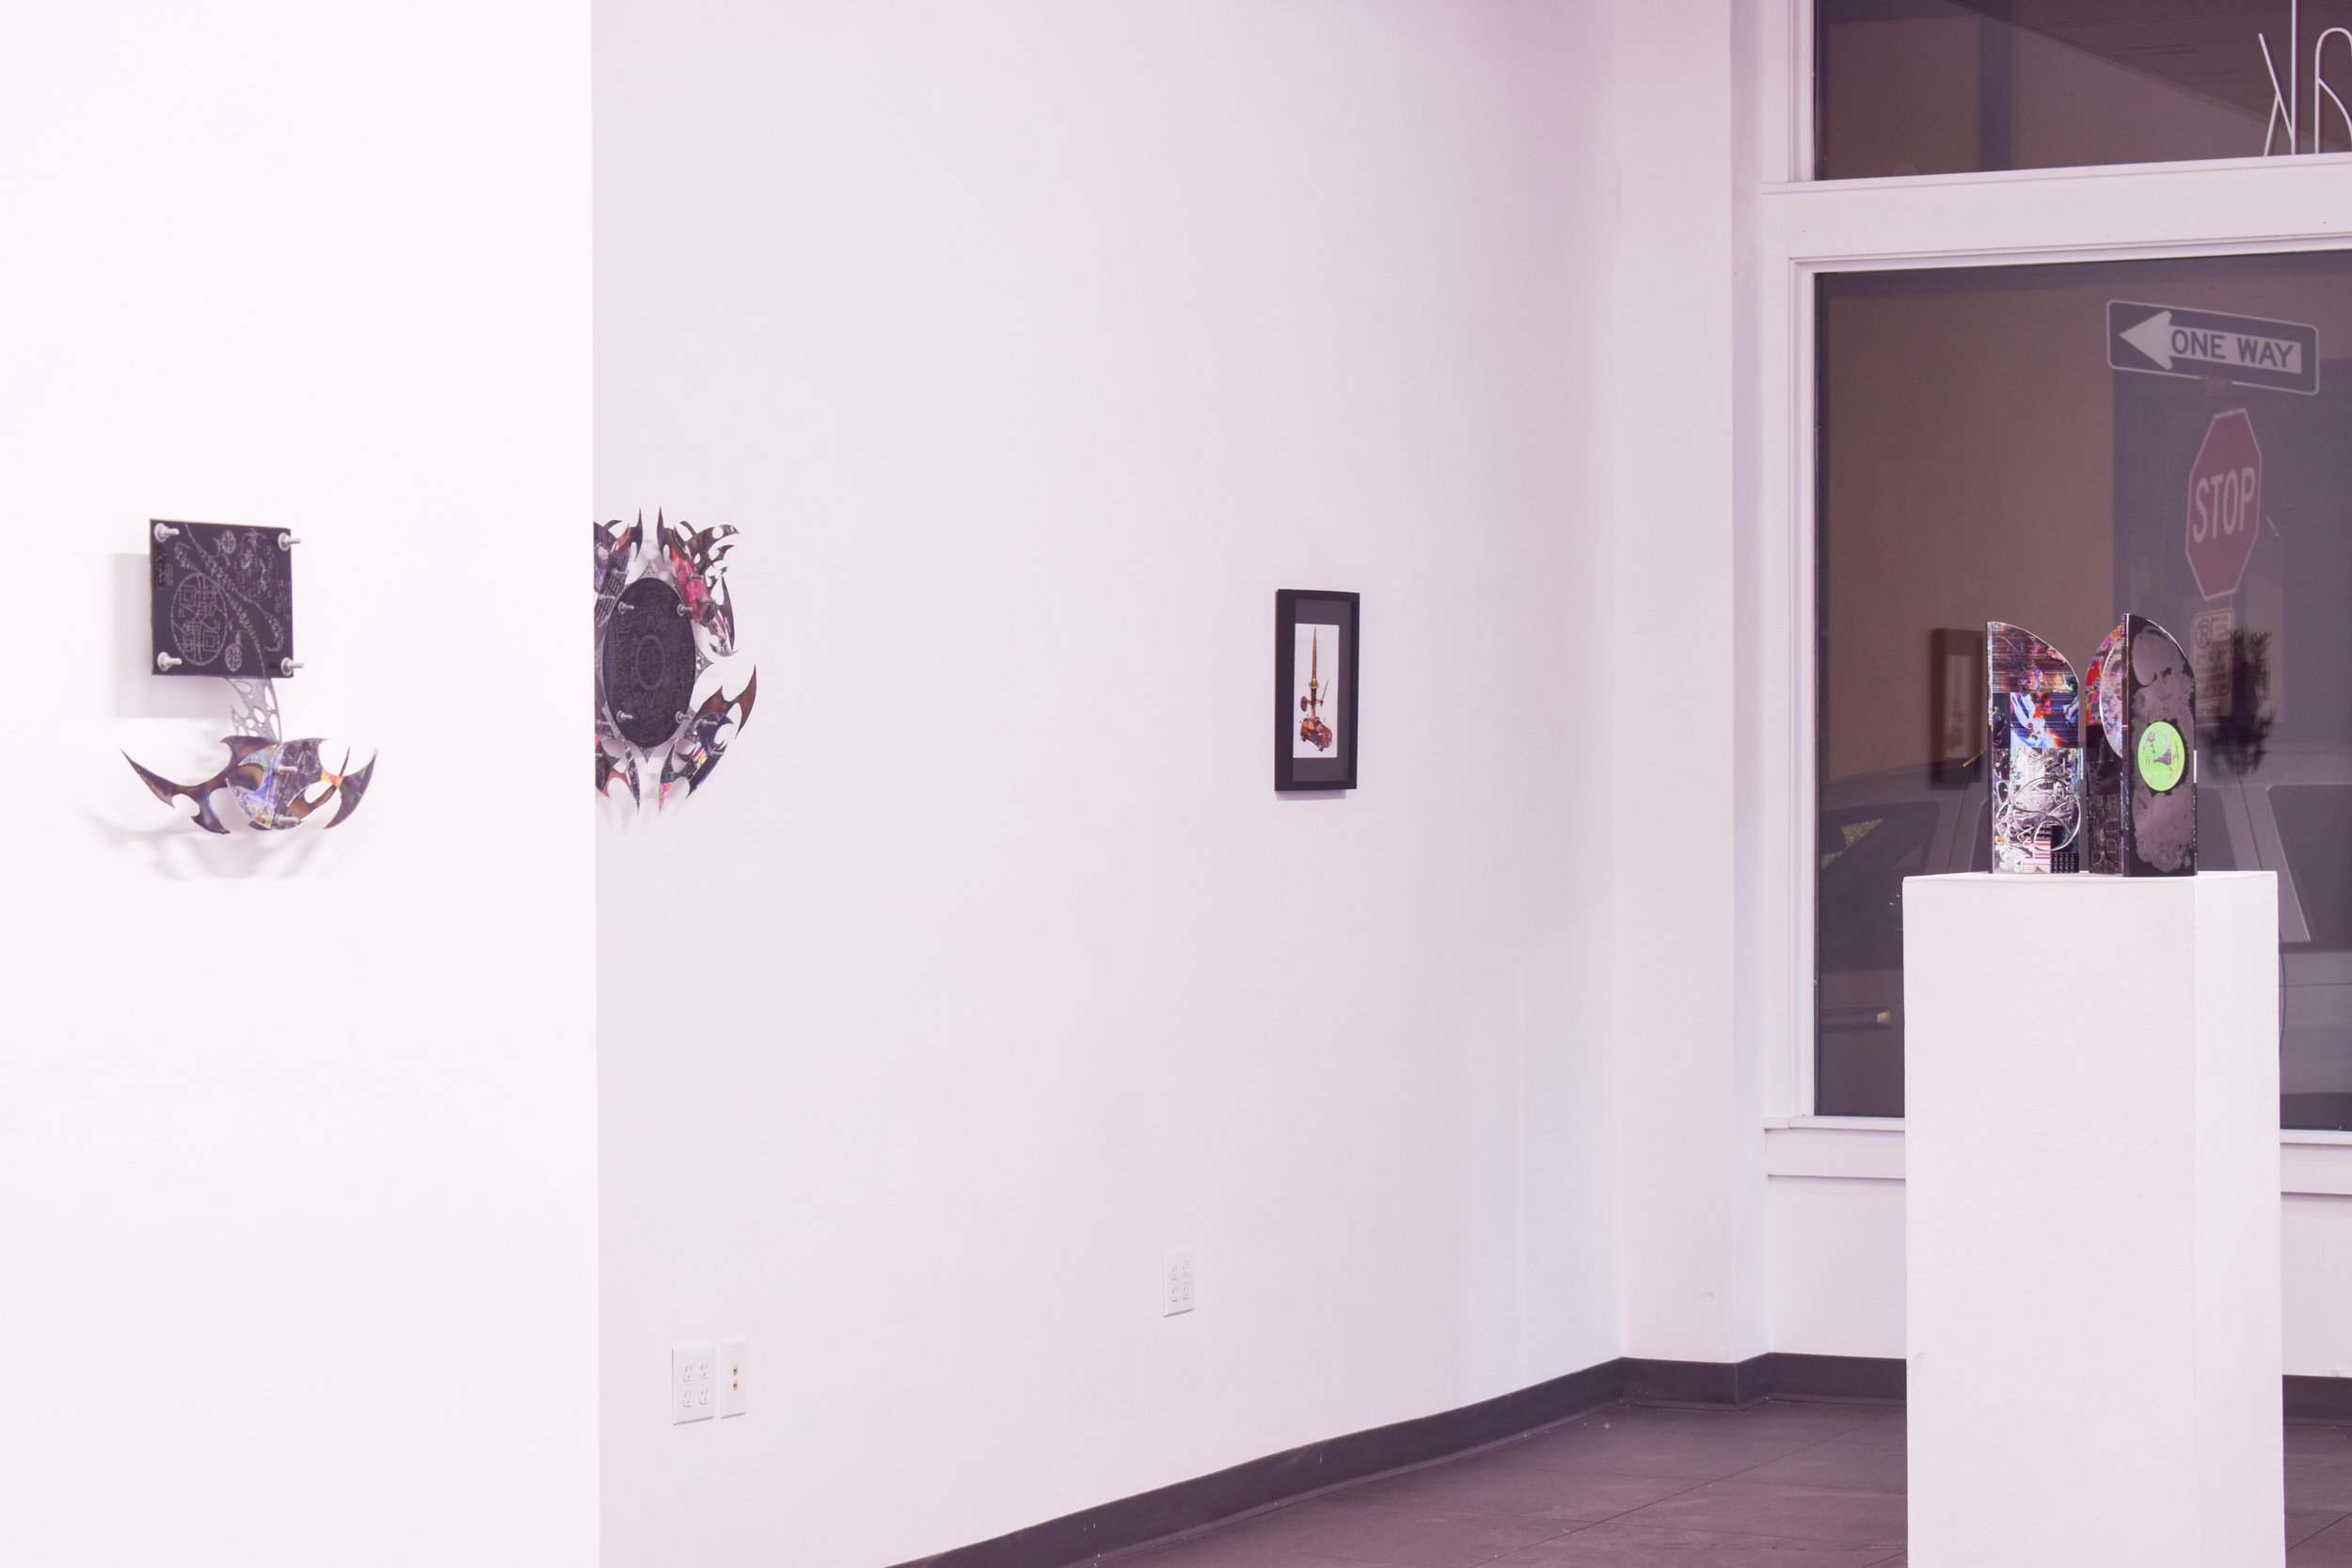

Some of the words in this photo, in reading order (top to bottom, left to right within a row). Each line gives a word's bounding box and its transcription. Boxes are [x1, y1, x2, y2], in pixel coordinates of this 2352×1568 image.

[2170, 329, 2227, 360] ONE
[2237, 337, 2294, 368] WAY
[2192, 467, 2255, 544] STOP
